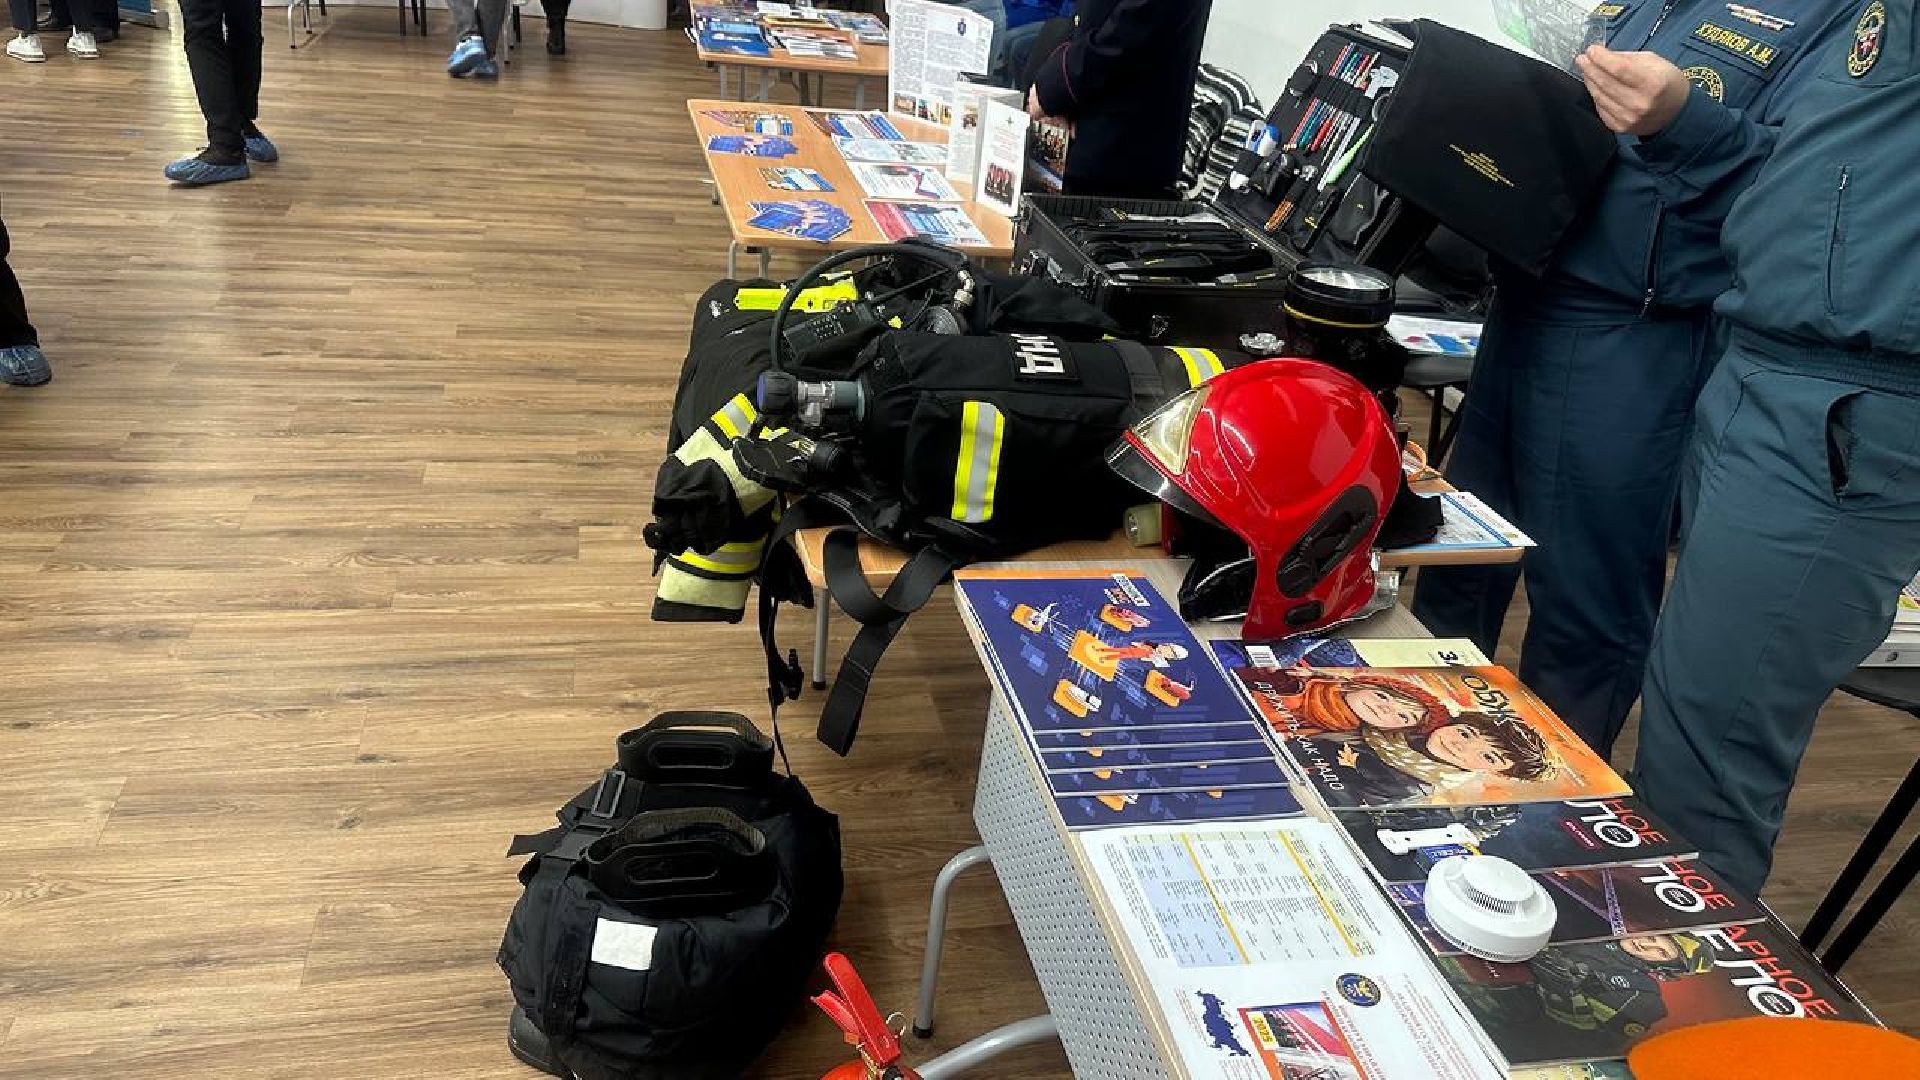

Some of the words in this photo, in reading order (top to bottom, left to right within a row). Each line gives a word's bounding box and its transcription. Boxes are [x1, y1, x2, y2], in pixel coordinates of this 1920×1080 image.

[1255, 681, 1299, 733] ДРУЖИТЬ
[1297, 734, 1321, 755] КАК
[1311, 758, 1345, 790] НАДО
